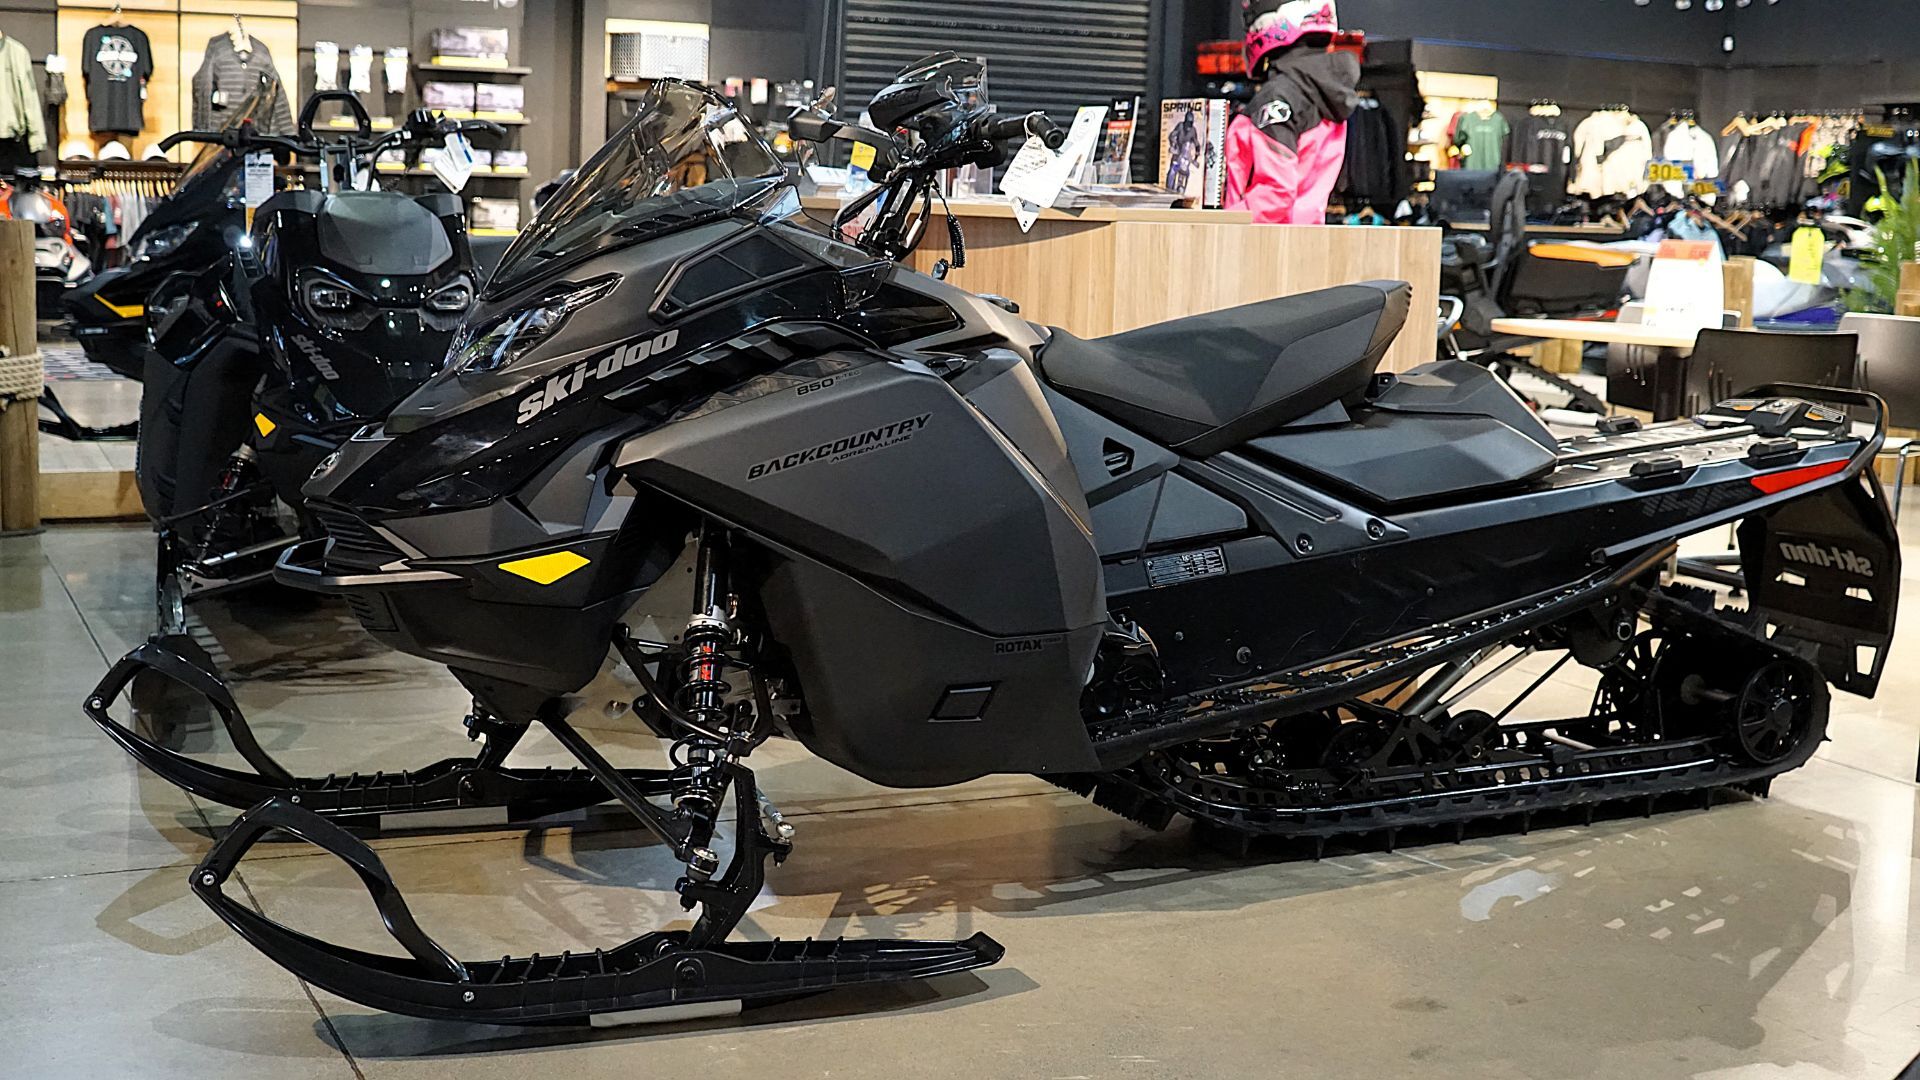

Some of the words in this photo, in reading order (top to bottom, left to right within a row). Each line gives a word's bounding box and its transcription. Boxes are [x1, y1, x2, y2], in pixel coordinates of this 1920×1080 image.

[1163, 102, 1202, 113] SPRING
[290, 334, 340, 380] ski-doo
[516, 329, 679, 425] ski-doo
[797, 378, 834, 395] 850
[747, 413, 932, 480] BACKCOUNTRY
[830, 434, 912, 463] ADRENALINE
[995, 638, 1043, 654] ROTAX
